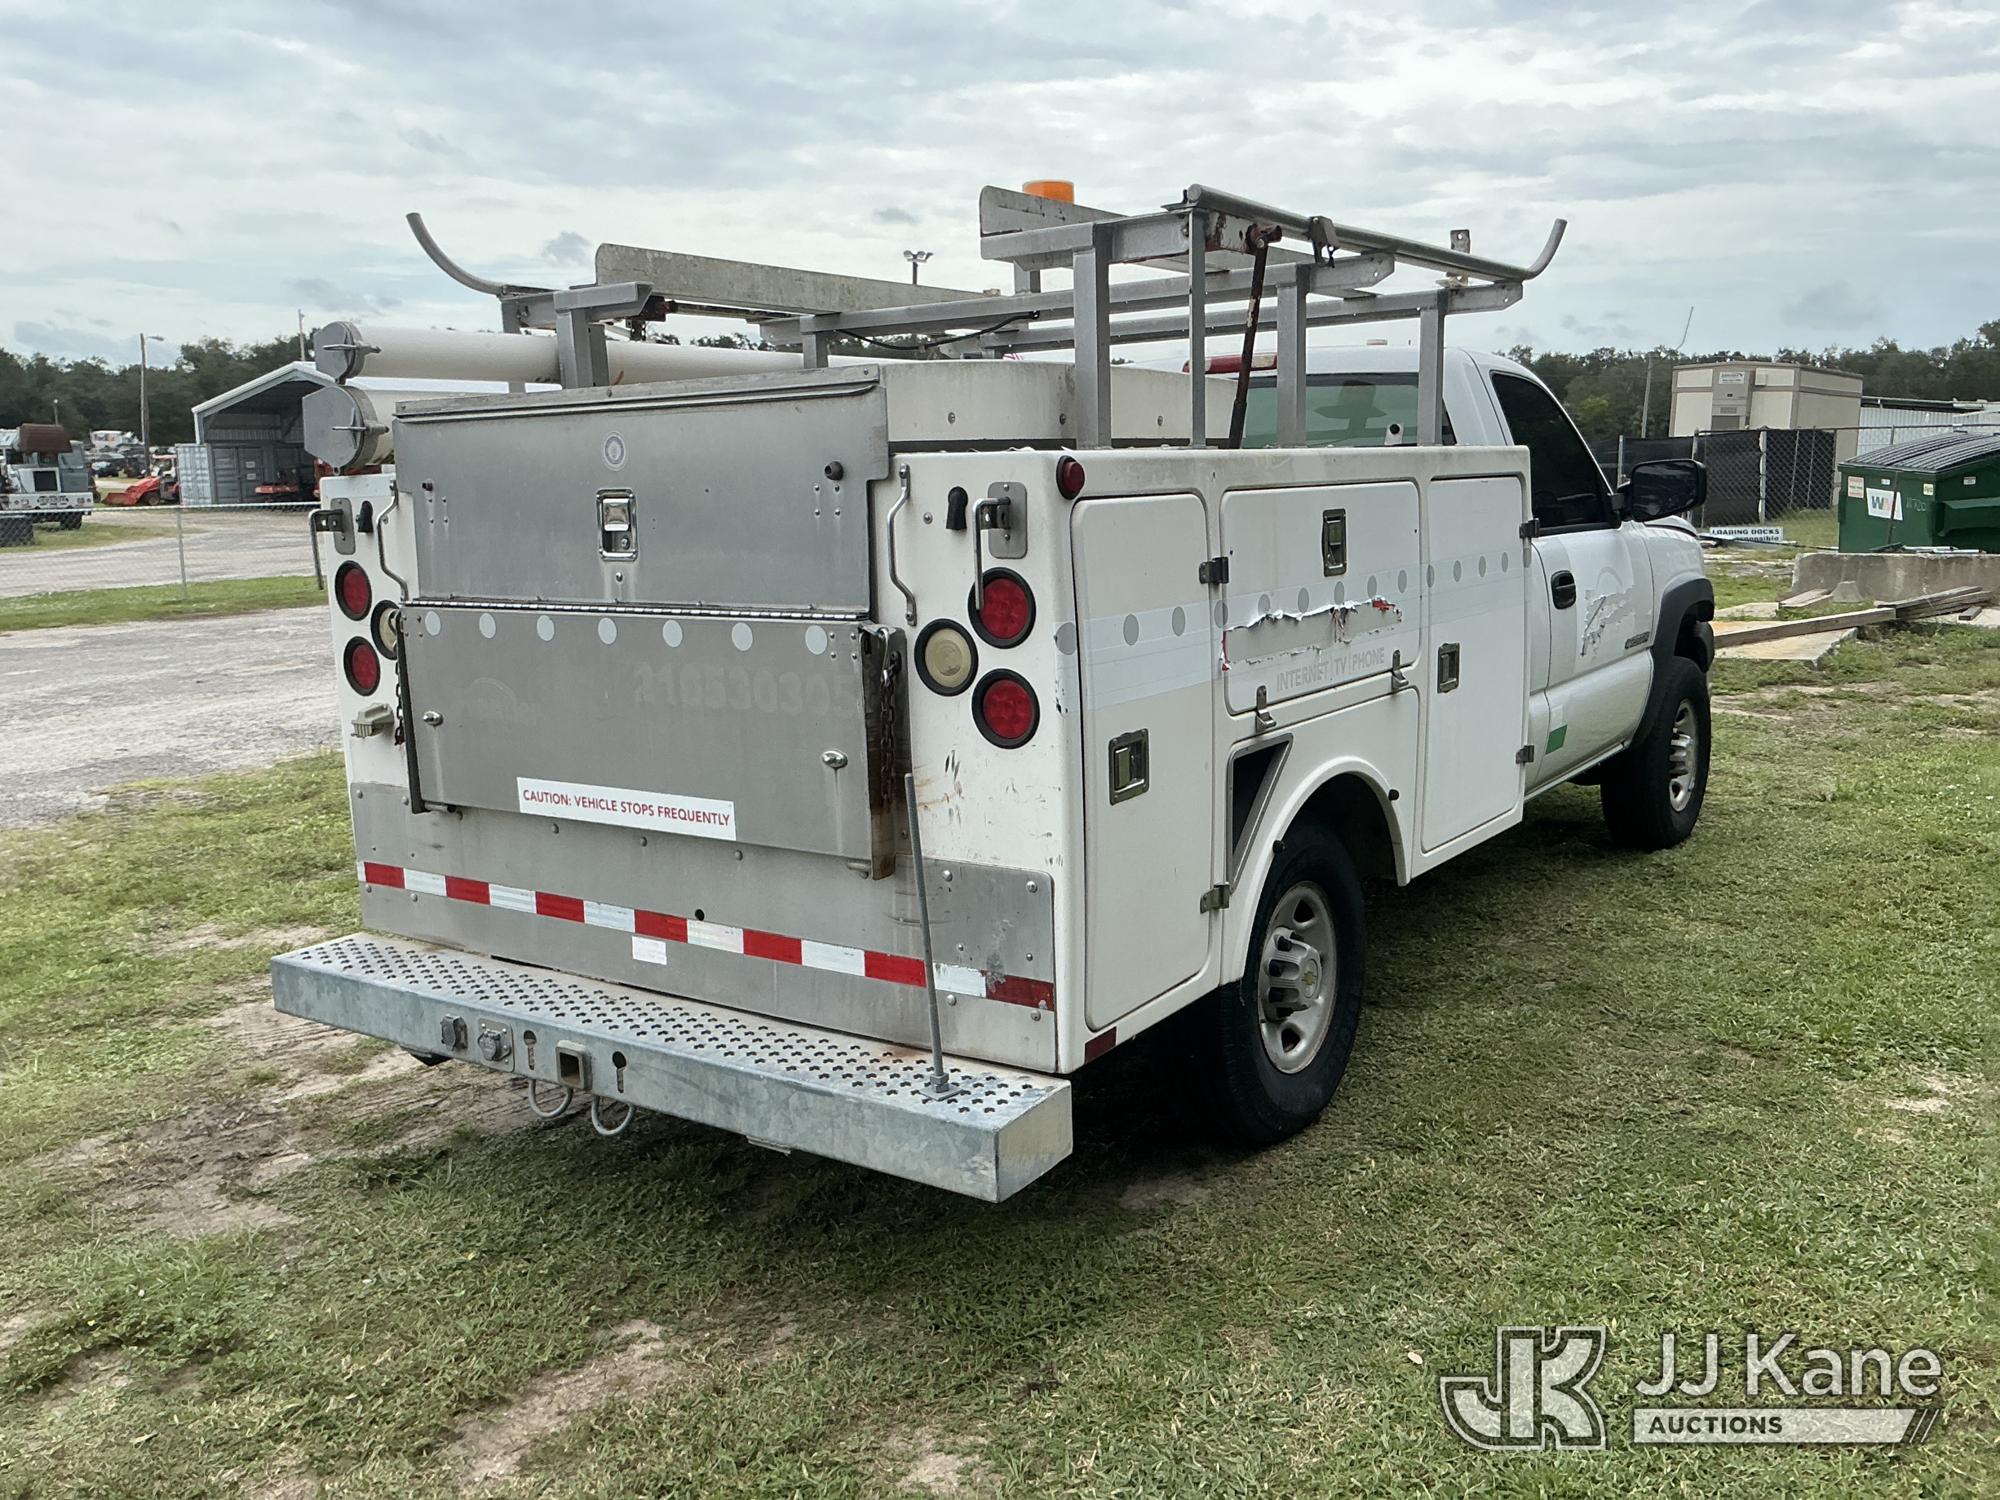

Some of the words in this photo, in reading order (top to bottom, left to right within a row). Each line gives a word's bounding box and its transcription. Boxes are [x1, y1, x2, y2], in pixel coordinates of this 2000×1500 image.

[1276, 661, 1329, 692] INTERNET
[1335, 656, 1347, 675] TV
[1352, 647, 1385, 670] PHONE
[522, 789, 572, 806] CAUTION:
[574, 796, 618, 812] VEHICLE
[620, 801, 655, 817] STOPS
[657, 806, 730, 827] FREQUENTLY
